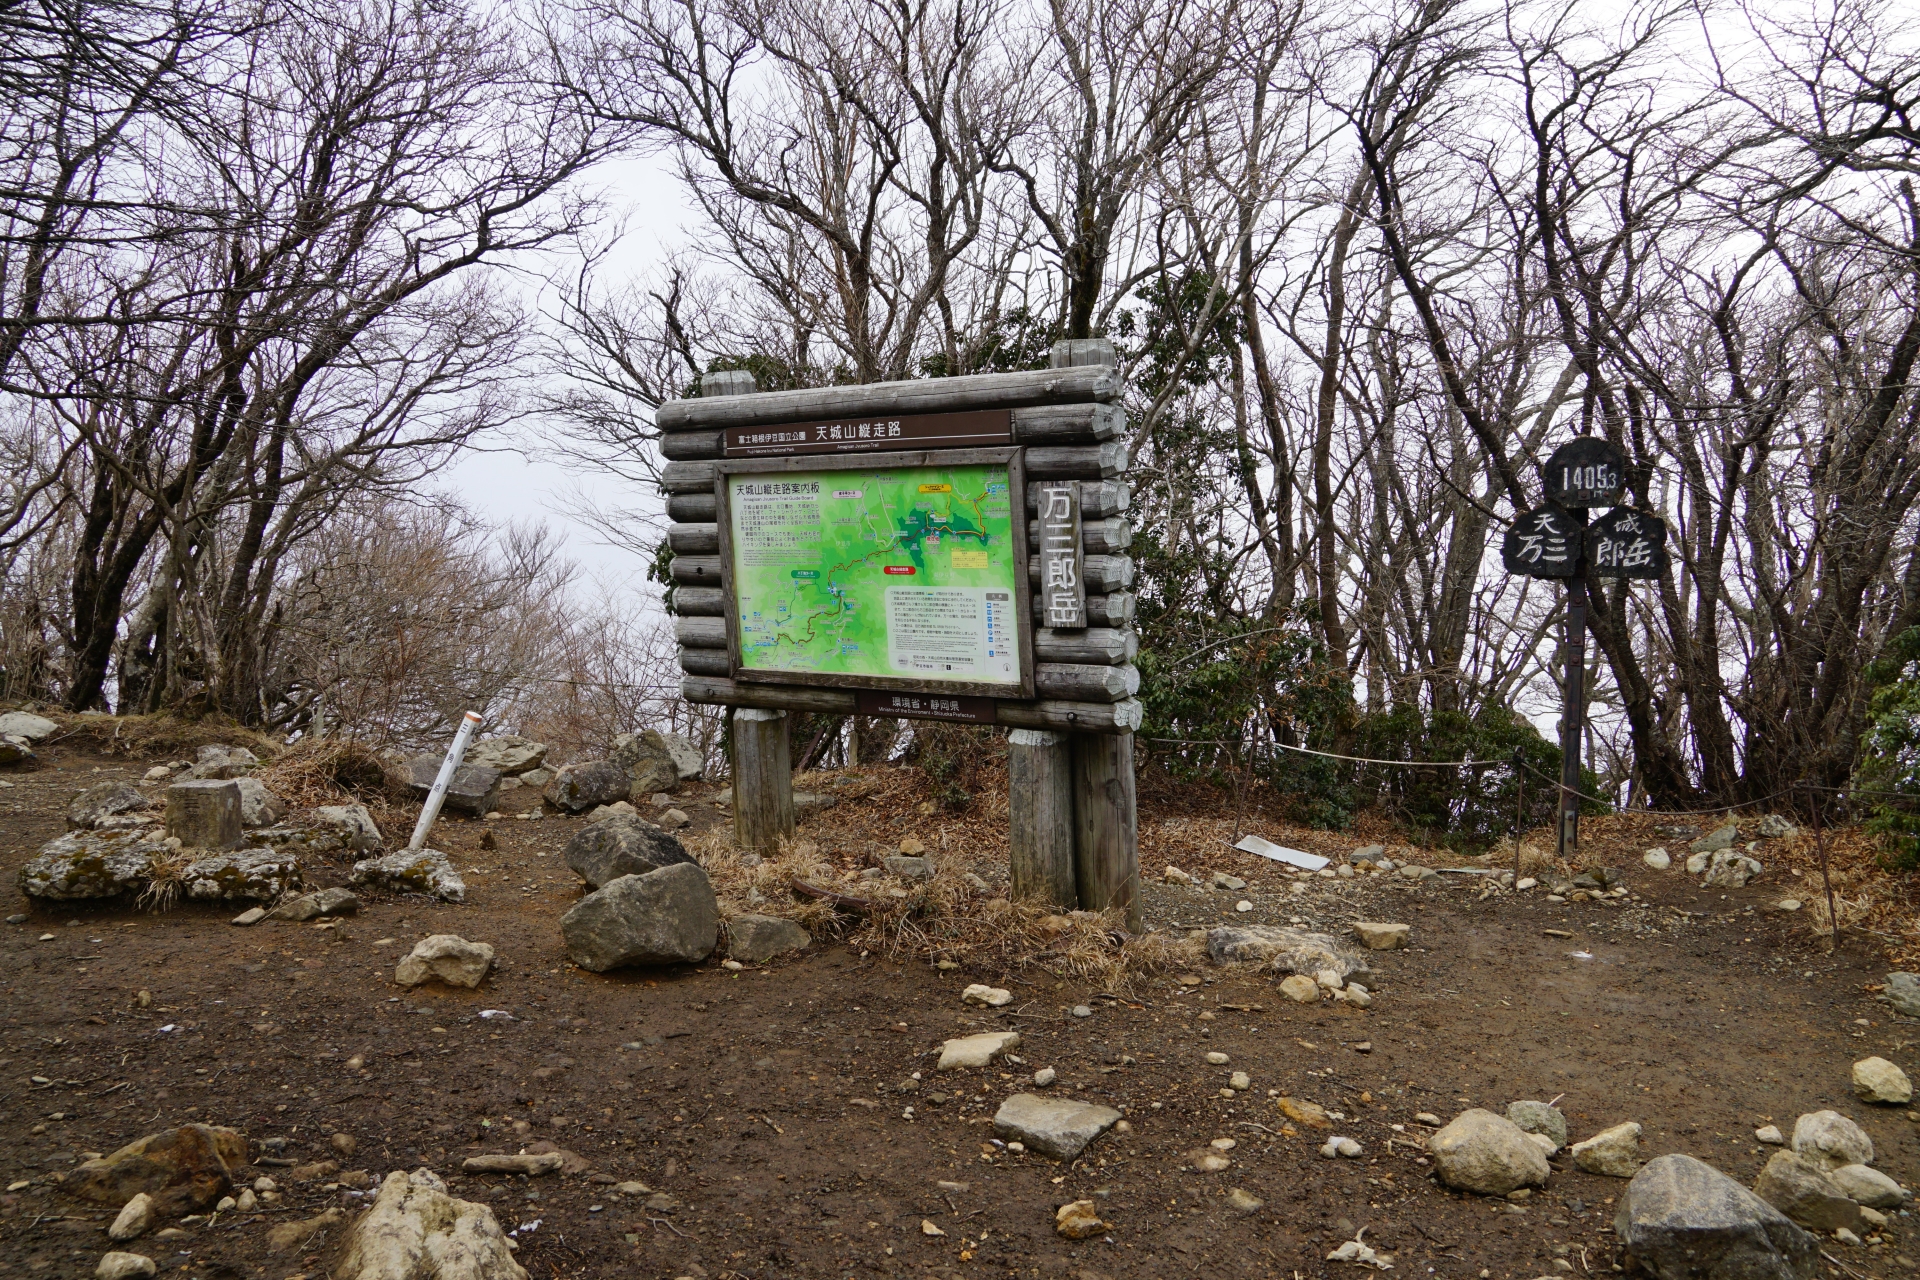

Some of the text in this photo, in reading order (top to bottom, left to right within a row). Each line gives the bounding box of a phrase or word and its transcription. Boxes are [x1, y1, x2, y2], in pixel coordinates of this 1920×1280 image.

[816, 421, 901, 440] 天城山縦走路
[736, 481, 820, 496] 天城山縦走路案内板
[1533, 513, 1643, 535] 天 城
[1042, 487, 1078, 622] 万三郎岳
[1516, 535, 1651, 567] 万三 郎岳
[892, 696, 960, 712] 環境省・静岡県
